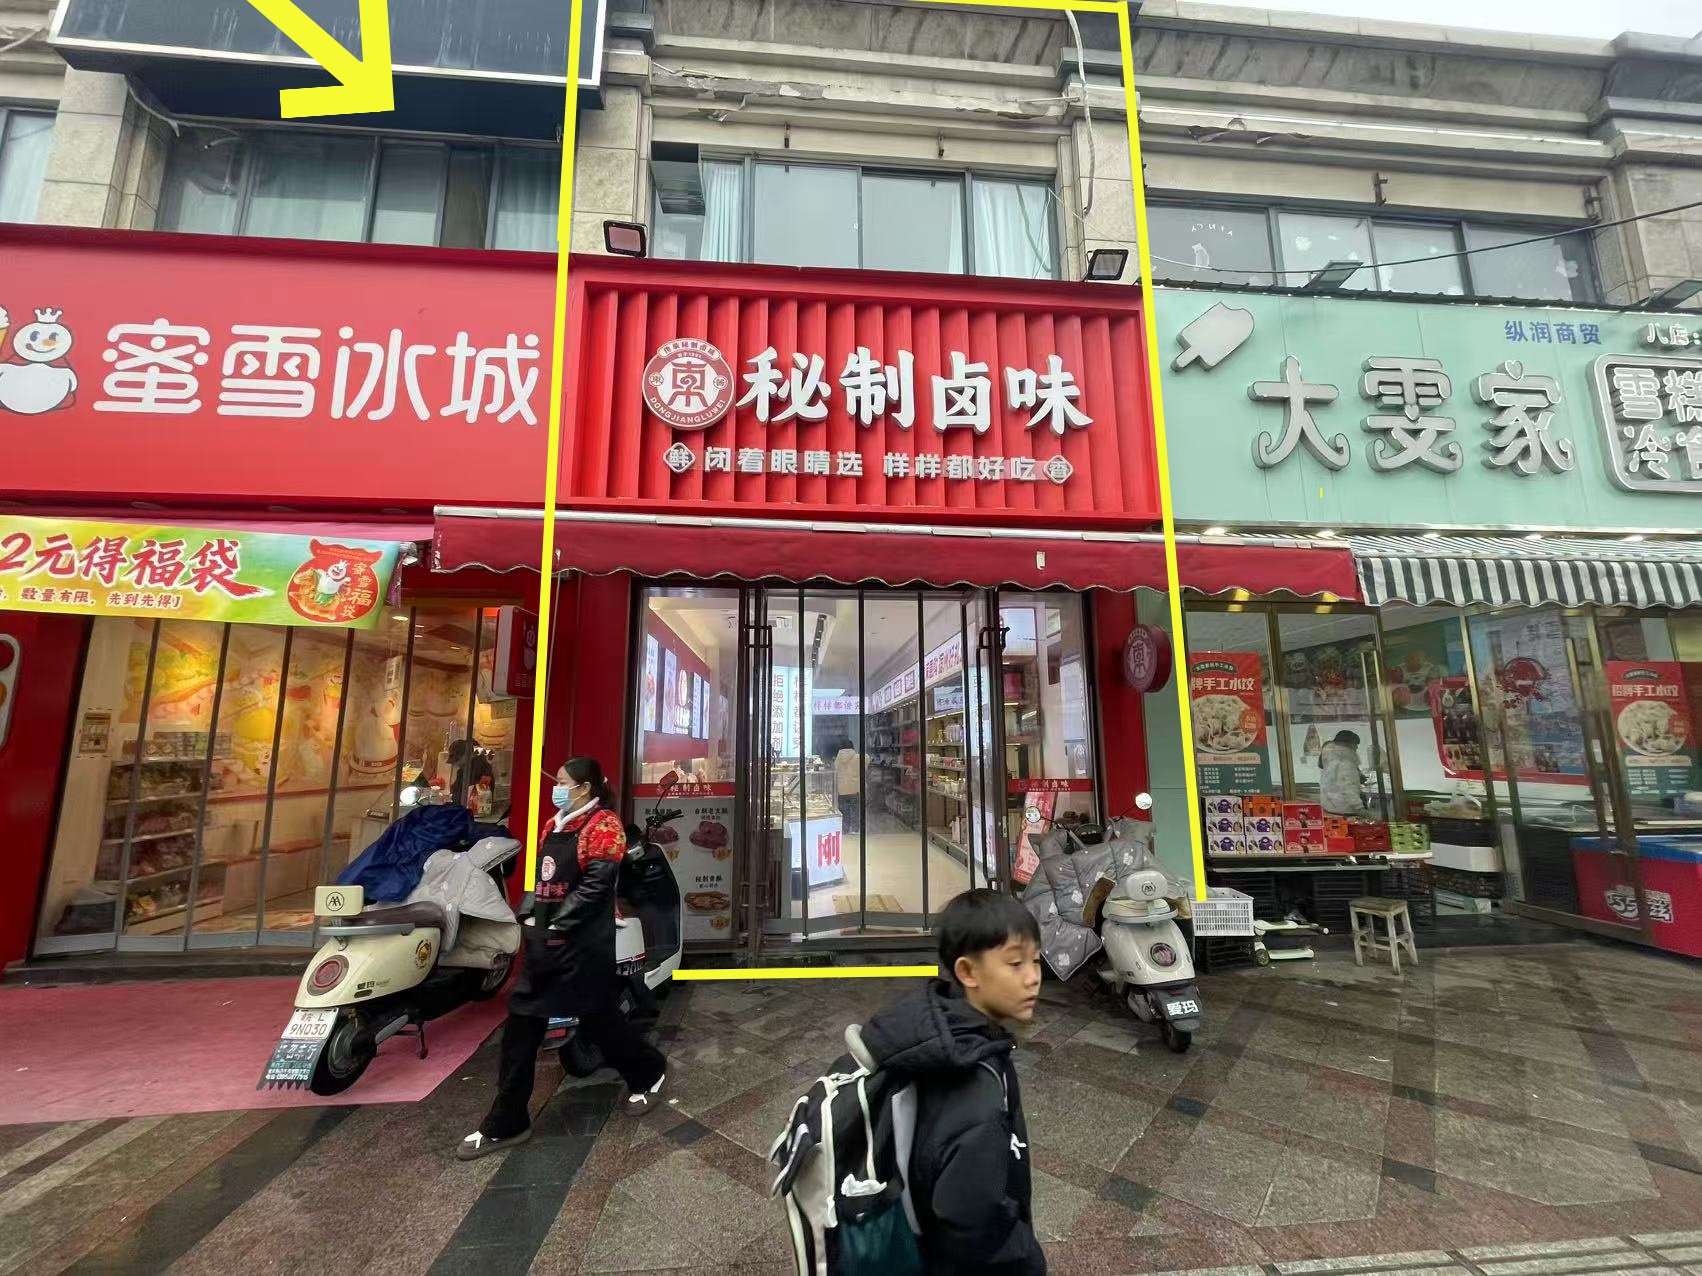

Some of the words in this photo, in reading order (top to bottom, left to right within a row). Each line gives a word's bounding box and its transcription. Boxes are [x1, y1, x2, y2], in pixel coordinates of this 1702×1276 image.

[1504, 320, 1602, 344] 纵润商贸
[93, 318, 541, 427] 蜜雪冰城
[736, 346, 1094, 436] 秘制卤味
[650, 396, 727, 424] DONGJIANGLUWEI
[1247, 354, 1577, 477] 大雯家
[704, 446, 864, 477] 闭着眼睛选
[883, 452, 1037, 480] 样样都好吃
[0, 532, 268, 597] 2元得福袋
[1166, 1000, 1200, 1016] 爱玛
